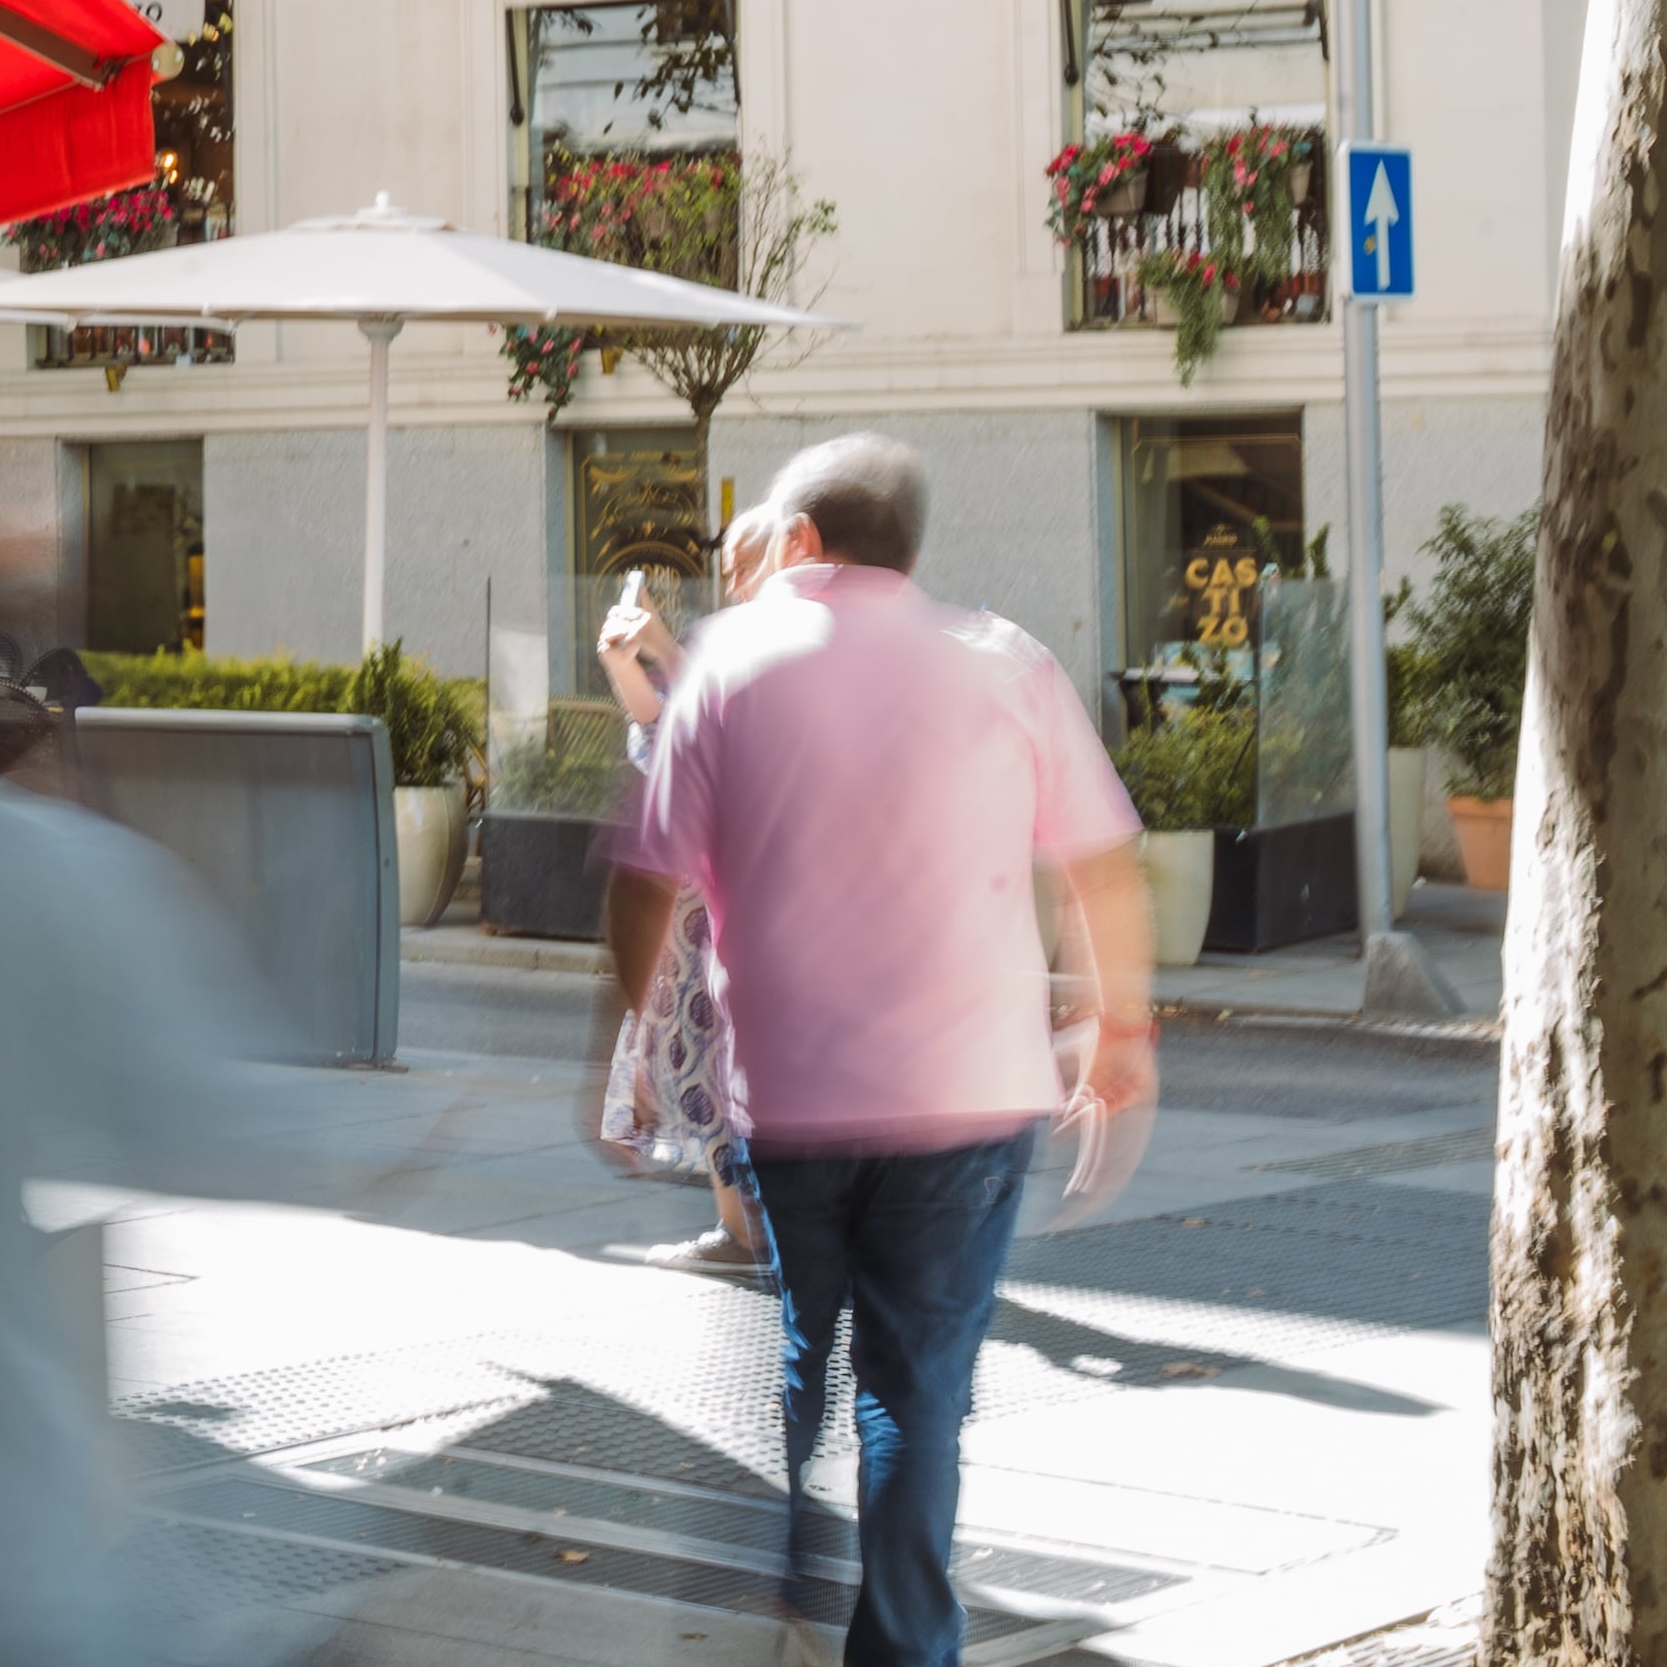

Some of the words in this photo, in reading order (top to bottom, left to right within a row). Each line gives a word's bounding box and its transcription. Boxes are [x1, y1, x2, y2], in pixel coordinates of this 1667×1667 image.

[1185, 556, 1258, 590] CAS
[1202, 587, 1241, 617] TI
[1196, 615, 1248, 647] ZO
